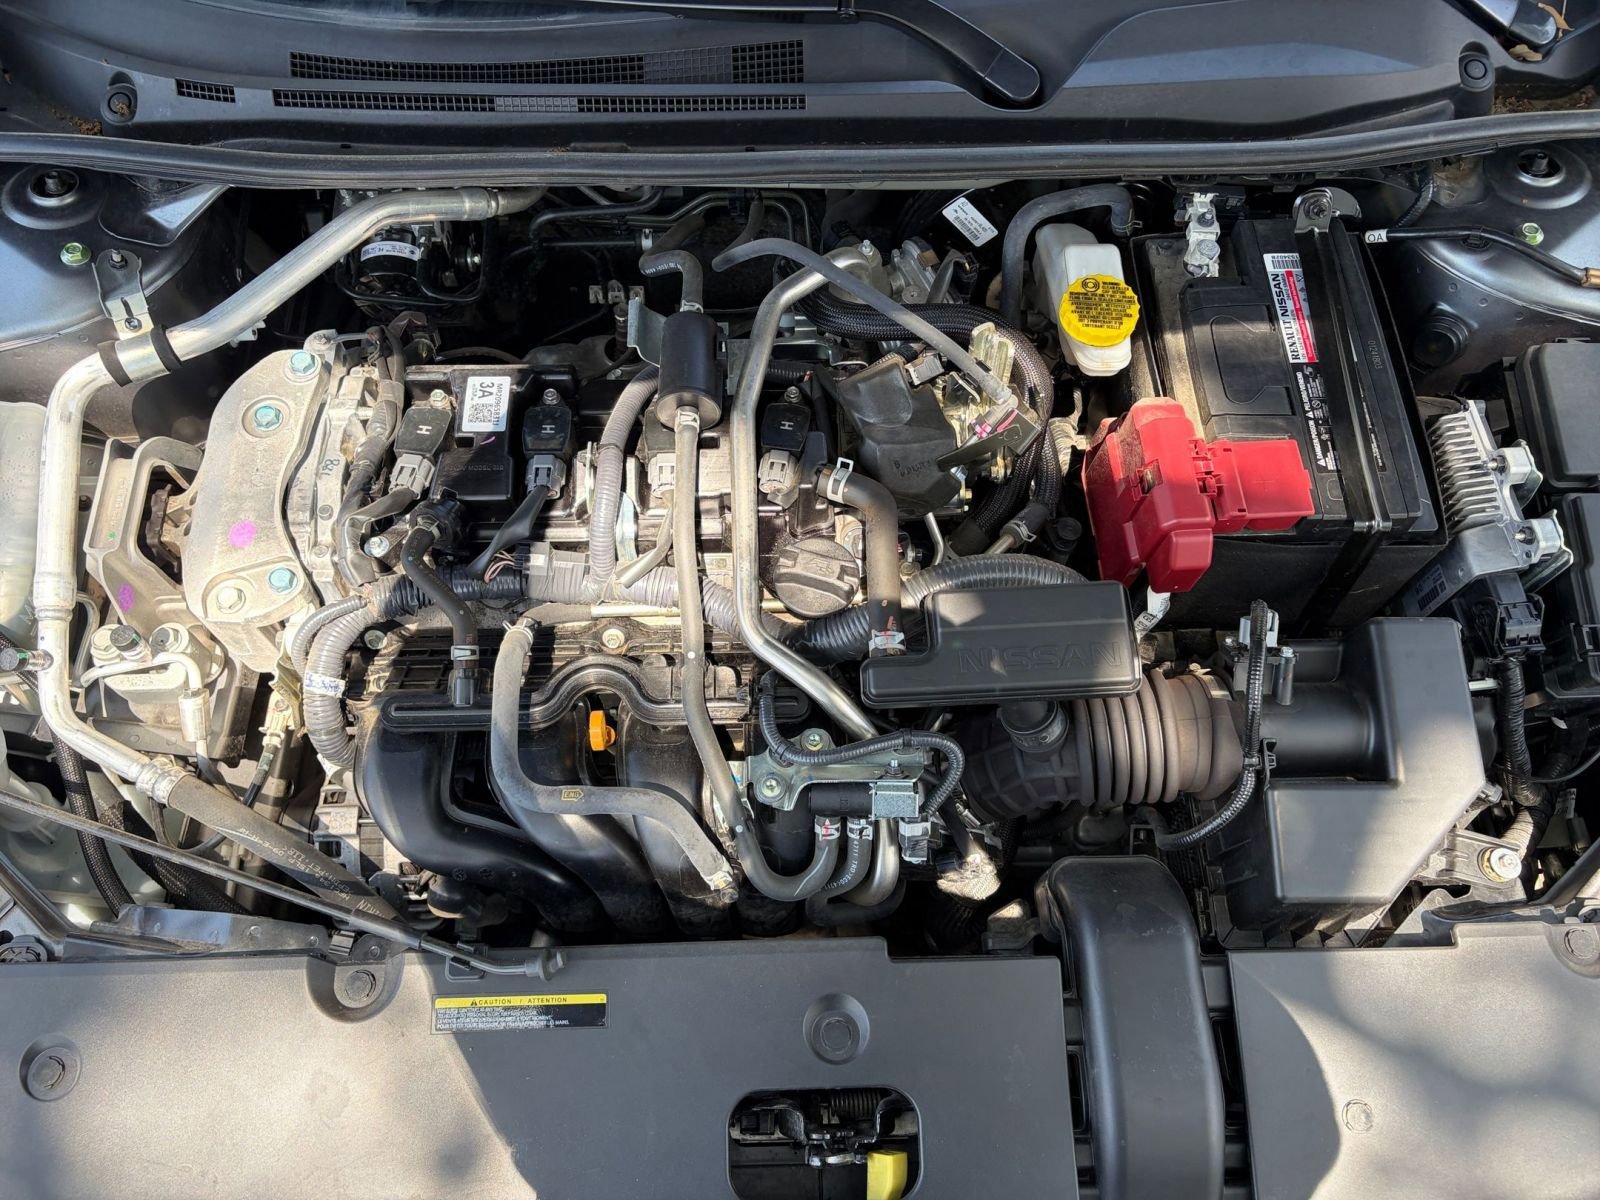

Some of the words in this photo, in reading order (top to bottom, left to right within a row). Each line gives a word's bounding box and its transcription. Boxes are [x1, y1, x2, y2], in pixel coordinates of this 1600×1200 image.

[1271, 273, 1290, 317] NISSAN
[1283, 320, 1301, 361] RENAULT
[478, 381, 495, 399] 3A
[959, 641, 1122, 672] NISSAN
